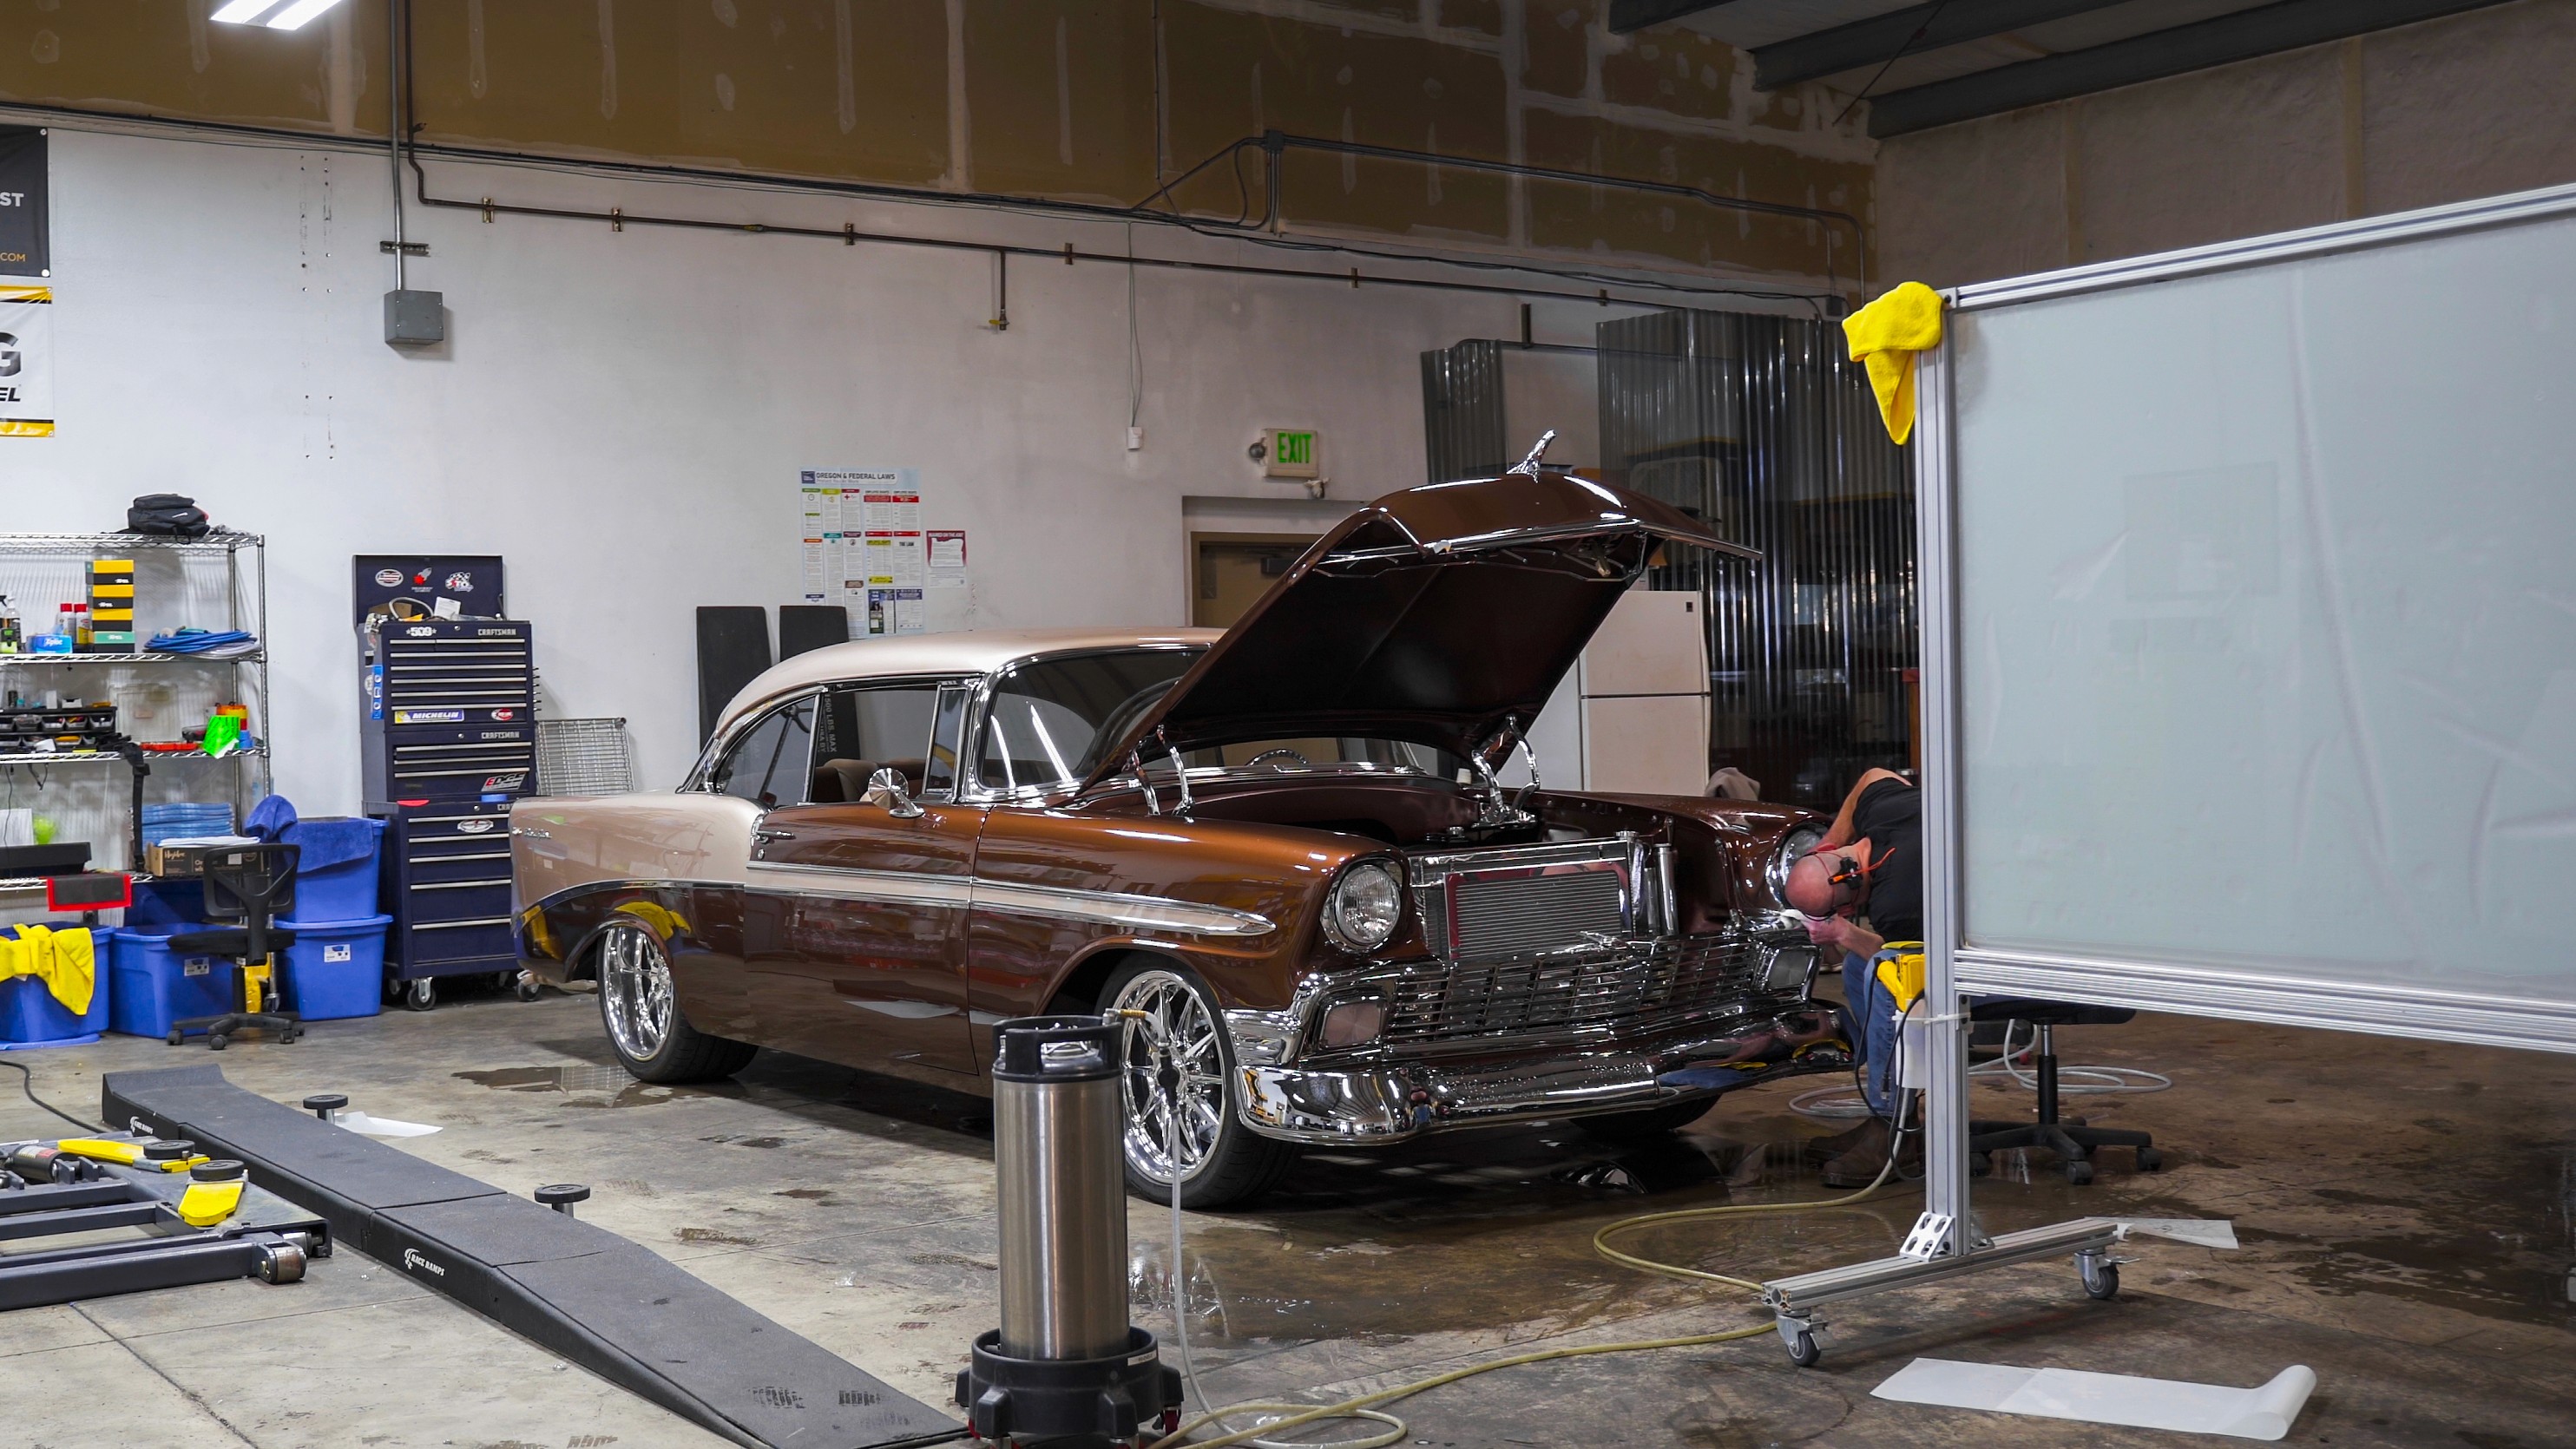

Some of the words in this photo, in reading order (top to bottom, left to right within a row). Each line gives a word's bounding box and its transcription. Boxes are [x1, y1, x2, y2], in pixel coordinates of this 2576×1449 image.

[0, 192, 24, 207] ST
[1278, 432, 1311, 463] EXIT
[411, 626, 433, 637] 509
[486, 772, 525, 786] EDGE
[411, 1254, 425, 1267] RACE
[425, 1260, 445, 1276] RAMPS
